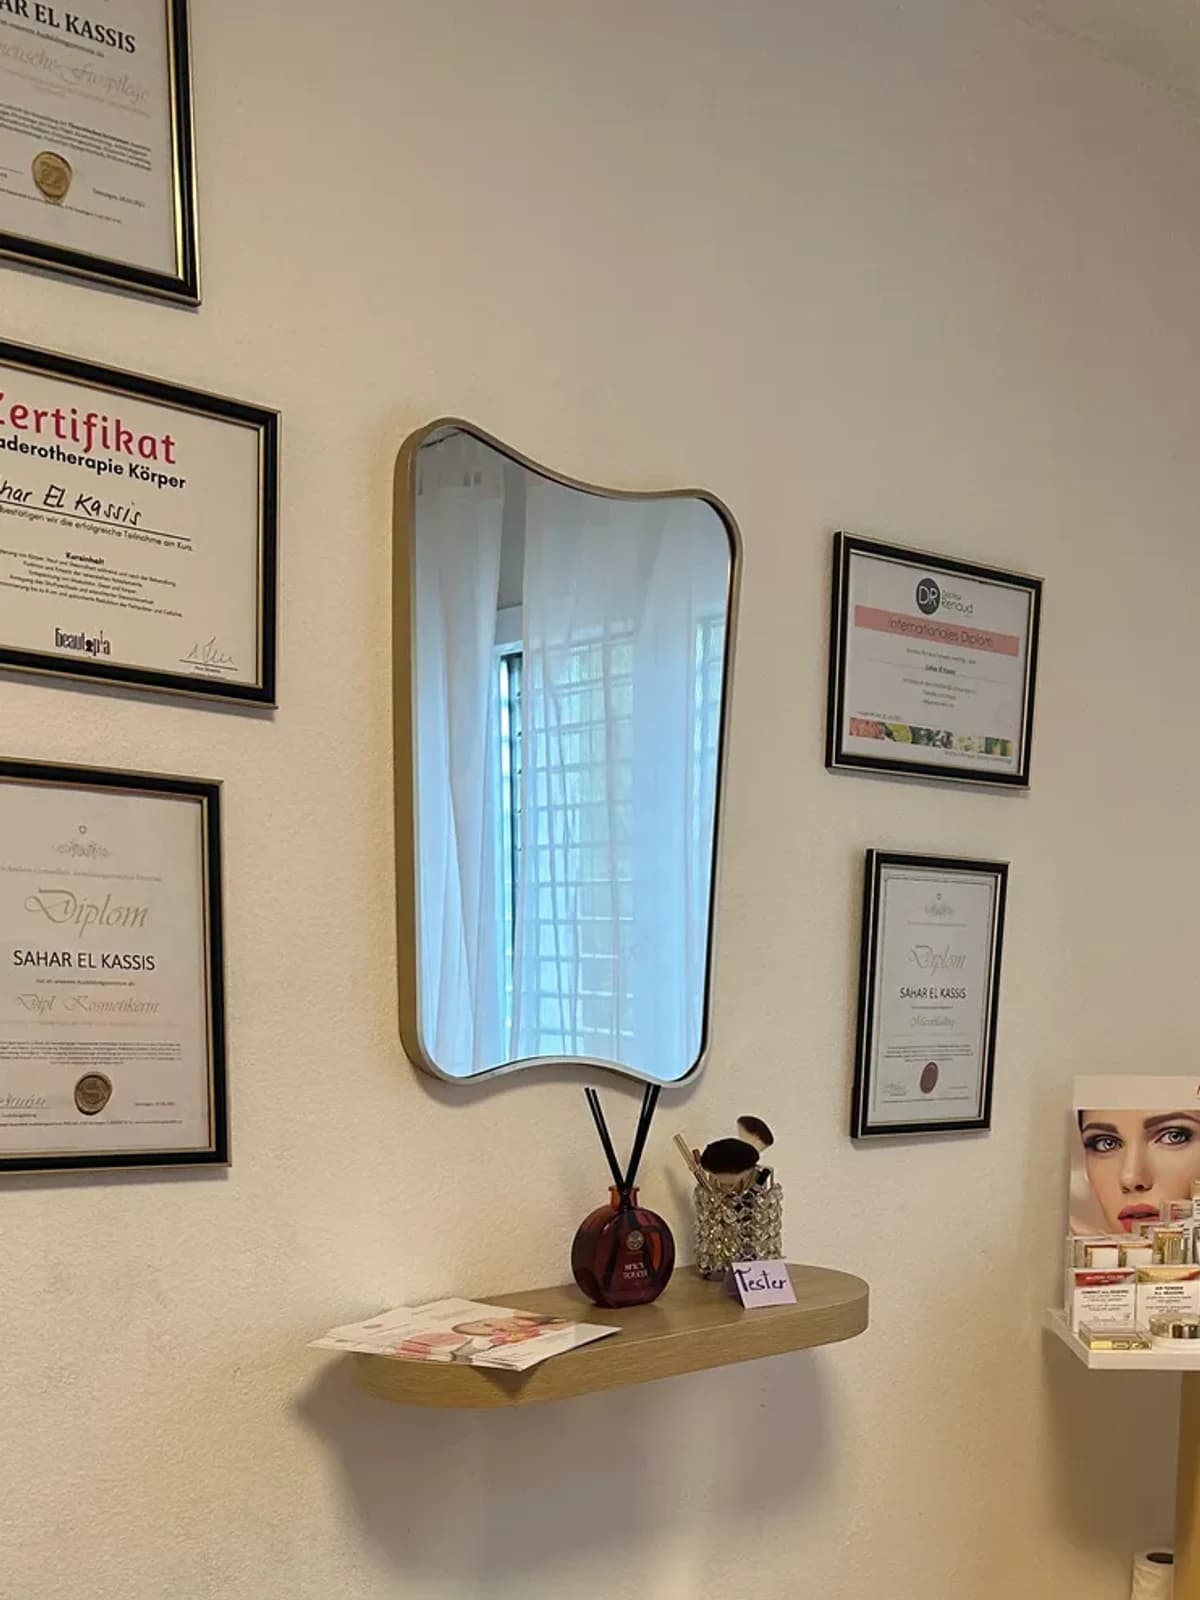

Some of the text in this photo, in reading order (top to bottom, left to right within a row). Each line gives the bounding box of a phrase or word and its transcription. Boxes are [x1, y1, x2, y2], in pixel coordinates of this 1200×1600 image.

[34, 2, 60, 28] EL
[65, 13, 136, 53] KASSIS
[129, 462, 187, 489] Körper
[74, 492, 143, 526] Kassis
[24, 887, 149, 939] Diplom
[13, 949, 156, 971] SAHAR EL KASSIS
[899, 986, 928, 999] SAHAR
[929, 986, 938, 999] EL
[734, 1266, 787, 1293] Tester
